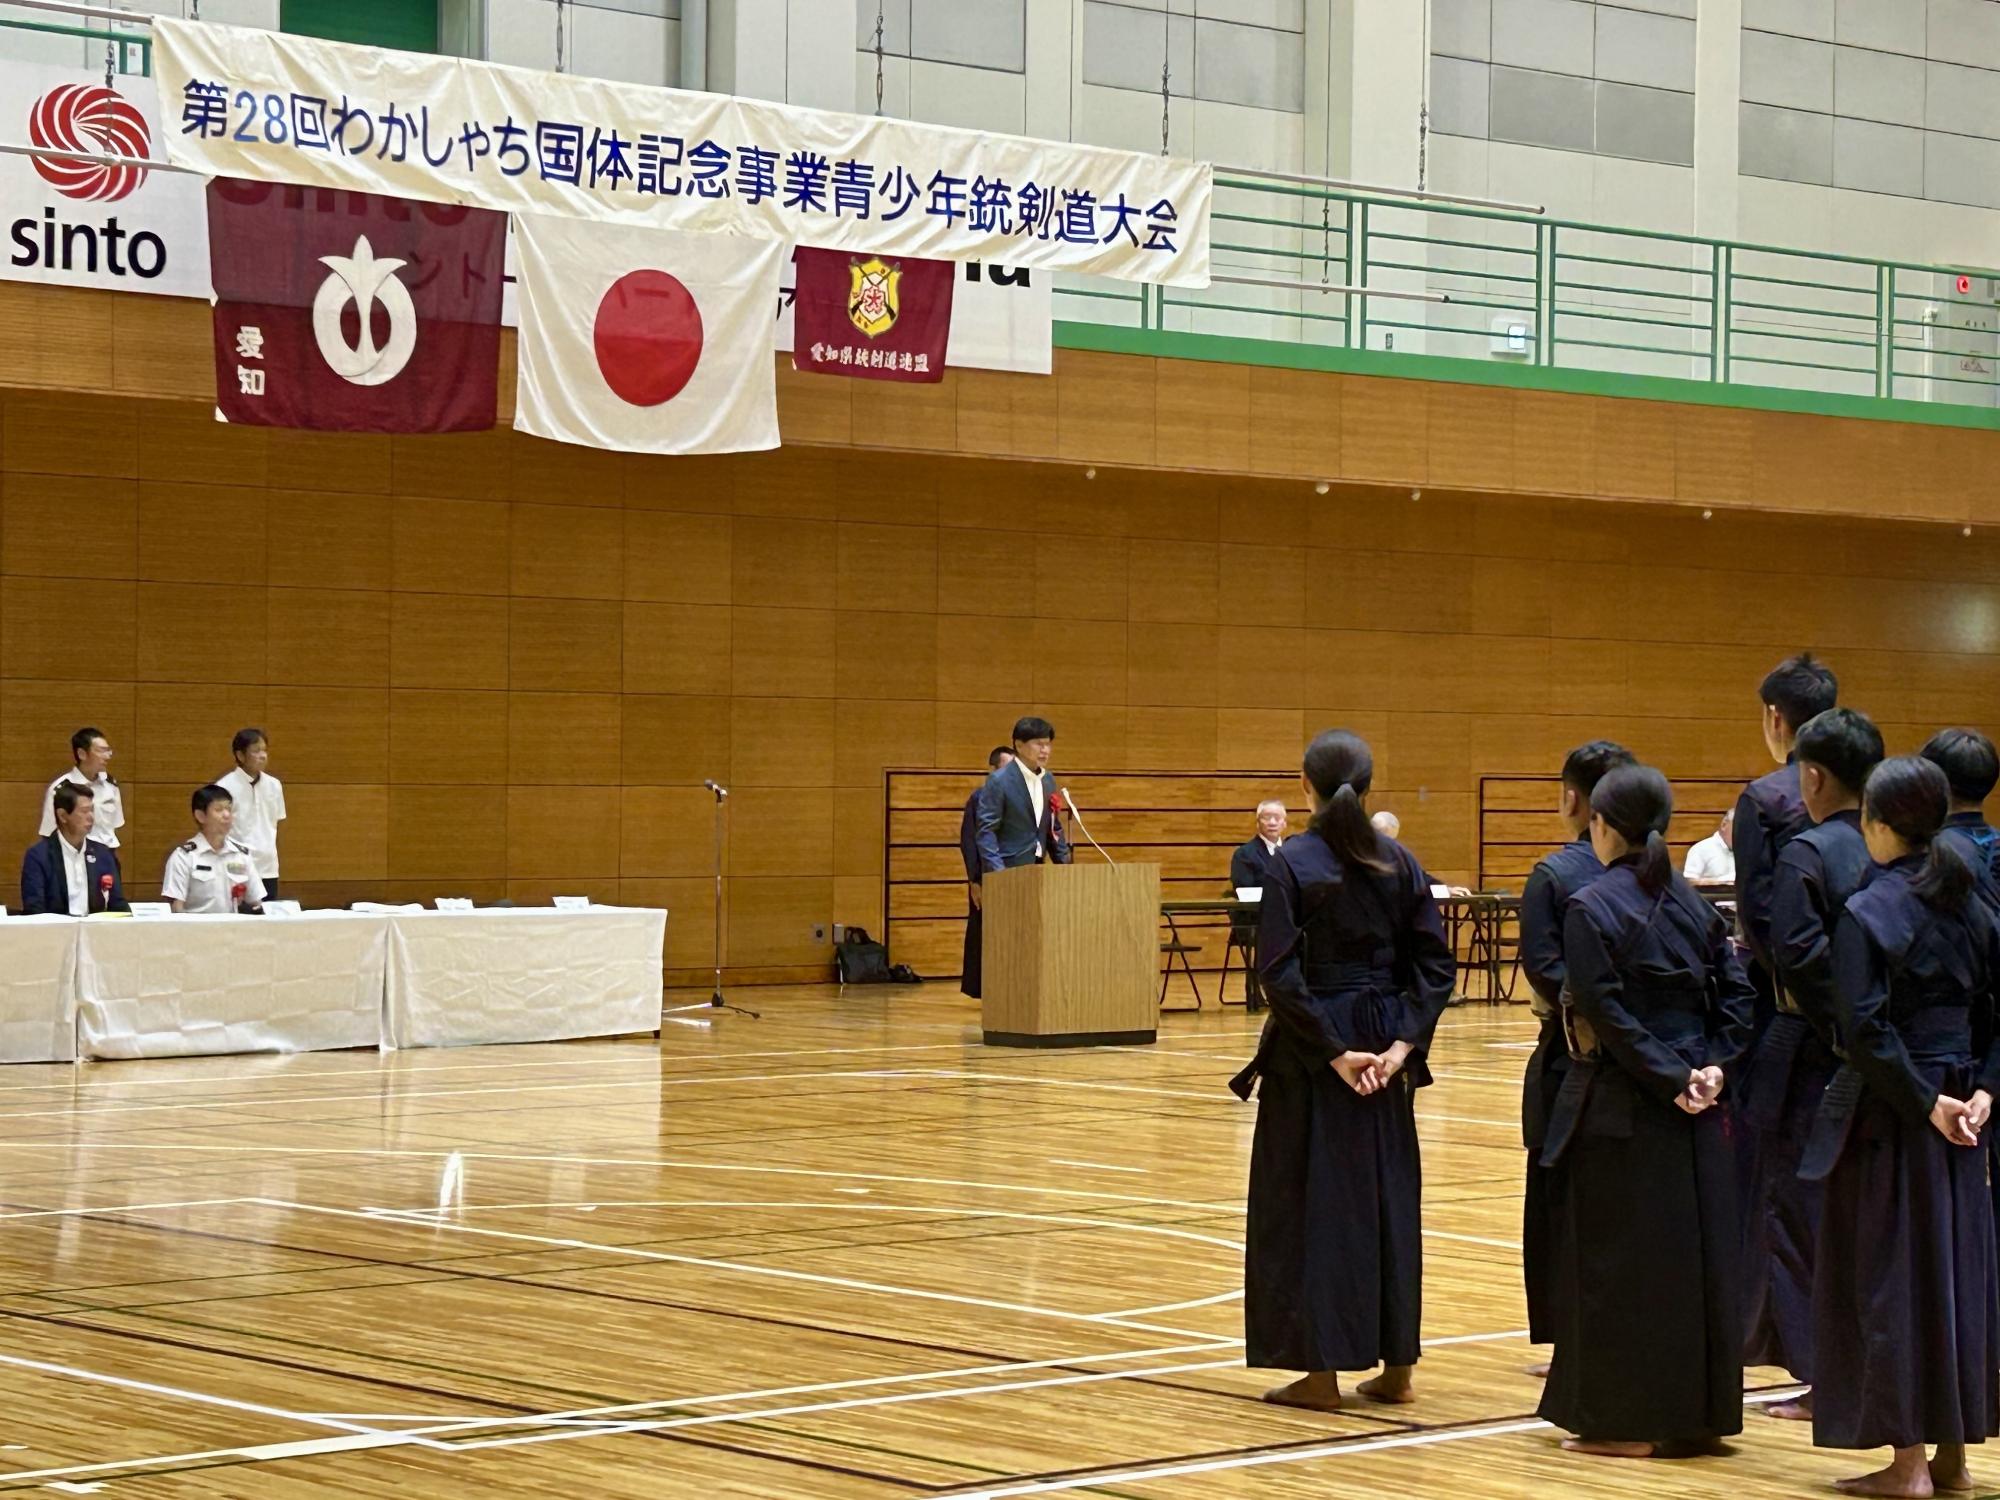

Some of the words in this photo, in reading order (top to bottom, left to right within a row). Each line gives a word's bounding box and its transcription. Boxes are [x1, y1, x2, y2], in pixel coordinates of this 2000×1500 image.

[181, 78, 1178, 253] 第28回わかしゃち国体記念事業青少年銃剣道大会
[11, 206, 167, 278] sinto
[235, 325, 266, 396] 愛知
